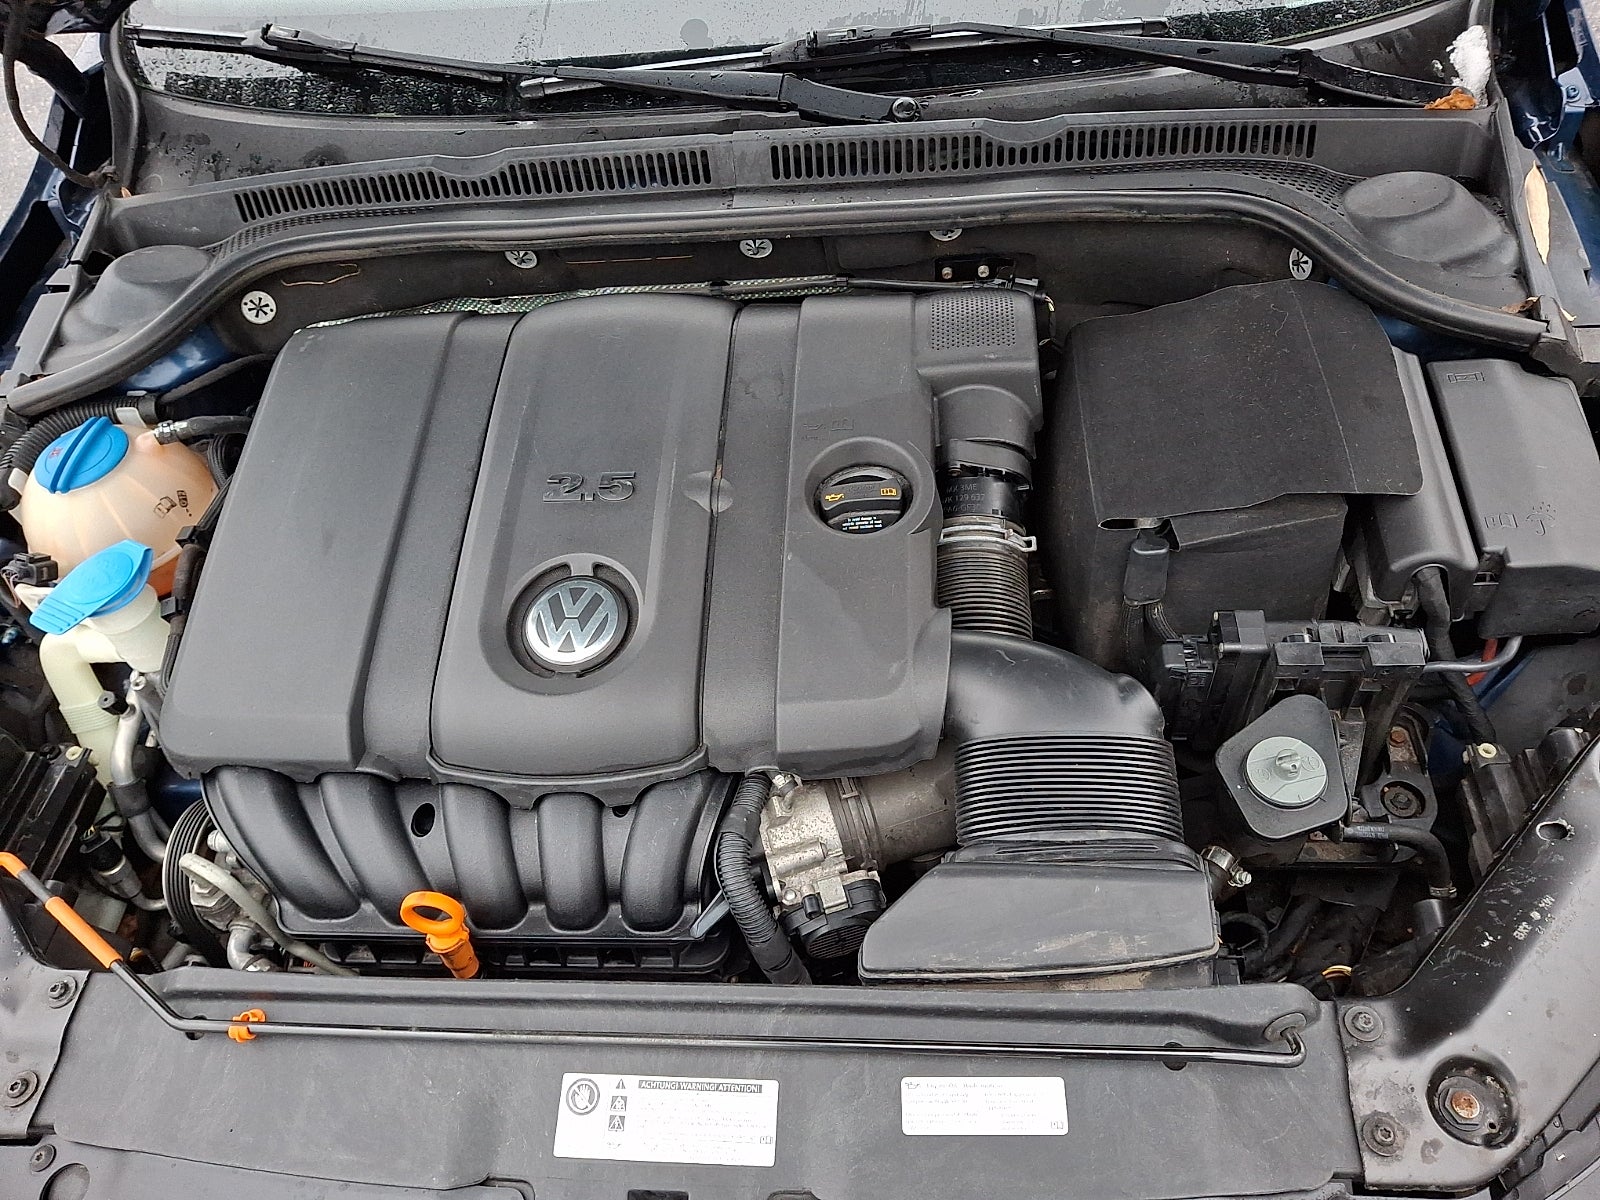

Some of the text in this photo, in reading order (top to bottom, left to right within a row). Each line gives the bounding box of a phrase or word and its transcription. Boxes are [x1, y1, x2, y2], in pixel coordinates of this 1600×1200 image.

[542, 471, 636, 503] 2.5
[527, 581, 618, 663] VW
[641, 1080, 760, 1093] ACHTUNG! WARNING! ATTENTION!
